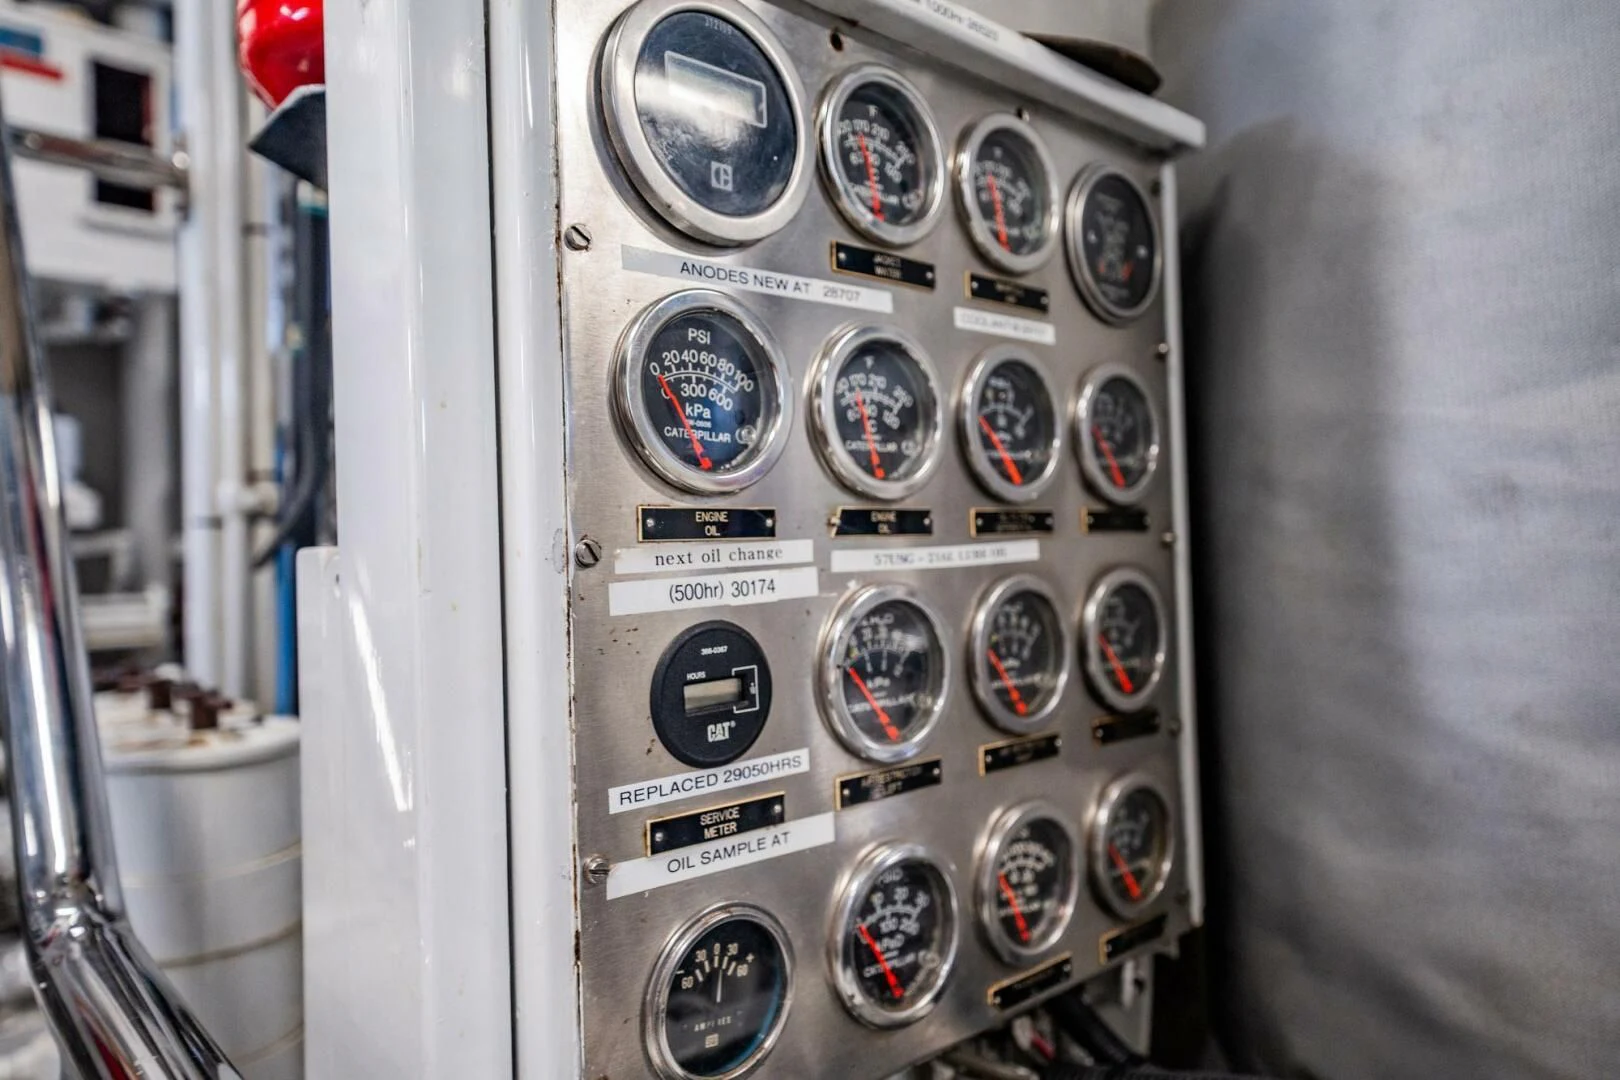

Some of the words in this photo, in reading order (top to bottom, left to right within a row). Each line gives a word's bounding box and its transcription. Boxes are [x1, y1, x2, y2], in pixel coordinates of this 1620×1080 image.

[680, 261, 749, 285] ANODES
[754, 274, 789, 292] NEW
[793, 281, 811, 295] AT
[823, 285, 861, 301] 28707
[688, 328, 711, 344] PSI
[649, 362, 661, 376] 0
[662, 350, 680, 366] 20
[681, 349, 698, 363] 40
[700, 351, 717, 367] 60
[717, 358, 734, 376] 80
[735, 370, 754, 392] 100
[680, 383, 707, 397] 300
[708, 388, 733, 411] 600
[685, 402, 712, 419] kPa
[695, 511, 728, 523] ENGINE
[704, 525, 720, 536] OIL
[655, 551, 692, 566] next
[701, 548, 721, 563] oil
[729, 547, 783, 561] change
[669, 581, 724, 604] (500hr)
[731, 579, 775, 598] 30174
[686, 671, 706, 681] HOURS
[707, 721, 731, 743] CAT
[619, 773, 718, 805] REPLACED
[723, 755, 802, 784] 29050HRS
[700, 807, 740, 826] SERVICE
[704, 822, 738, 839] METER
[667, 858, 696, 874] OIL
[700, 836, 767, 866] SAMPLE
[771, 831, 791, 846] AT
[713, 943, 721, 955] 0
